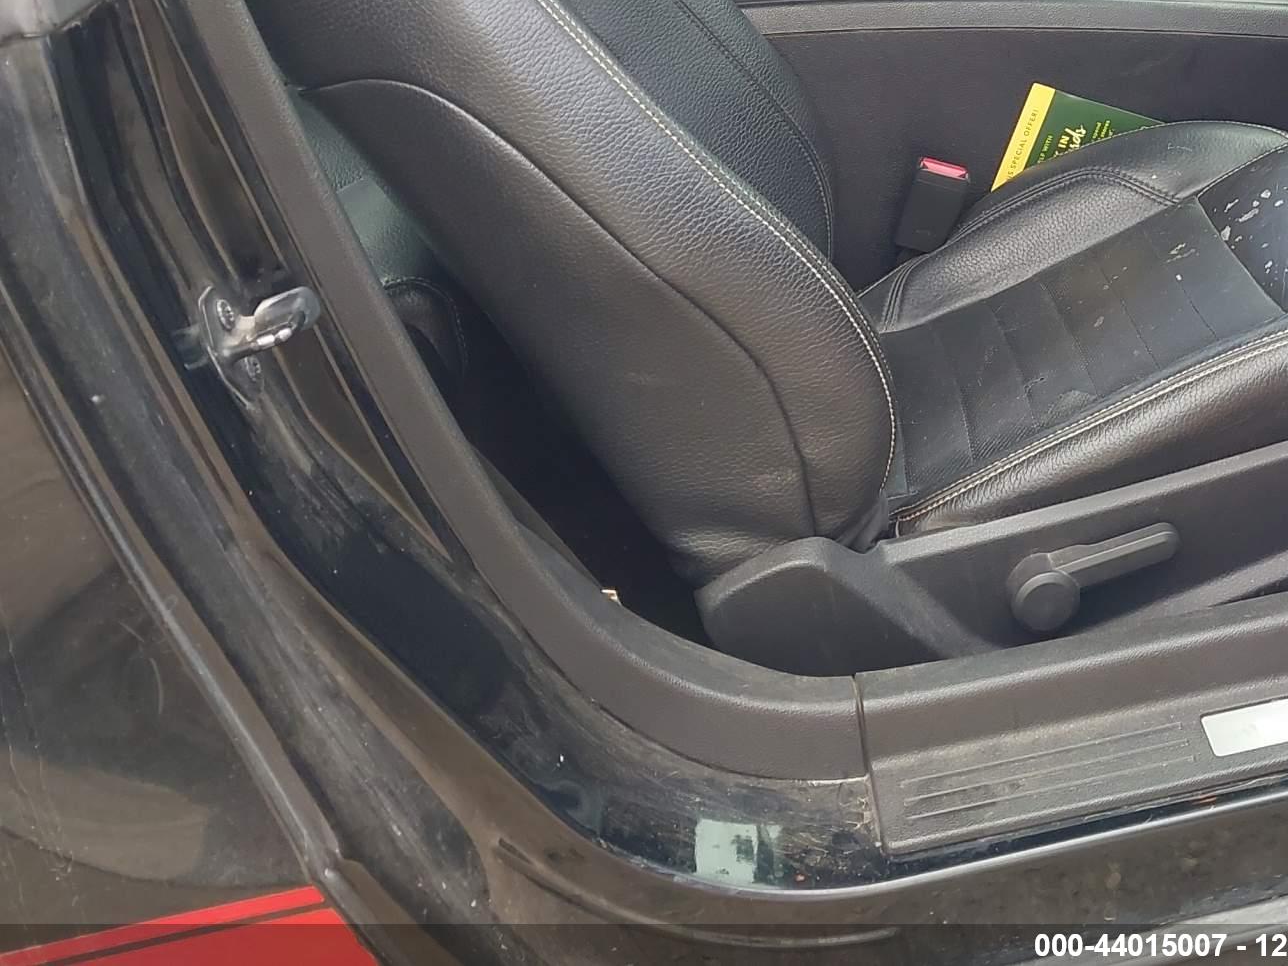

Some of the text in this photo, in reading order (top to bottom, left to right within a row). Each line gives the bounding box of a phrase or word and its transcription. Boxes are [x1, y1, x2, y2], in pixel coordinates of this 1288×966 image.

[1010, 138, 1026, 170] SPECIAL
[1023, 108, 1040, 138] OFFER!
[1057, 134, 1070, 149] IN
